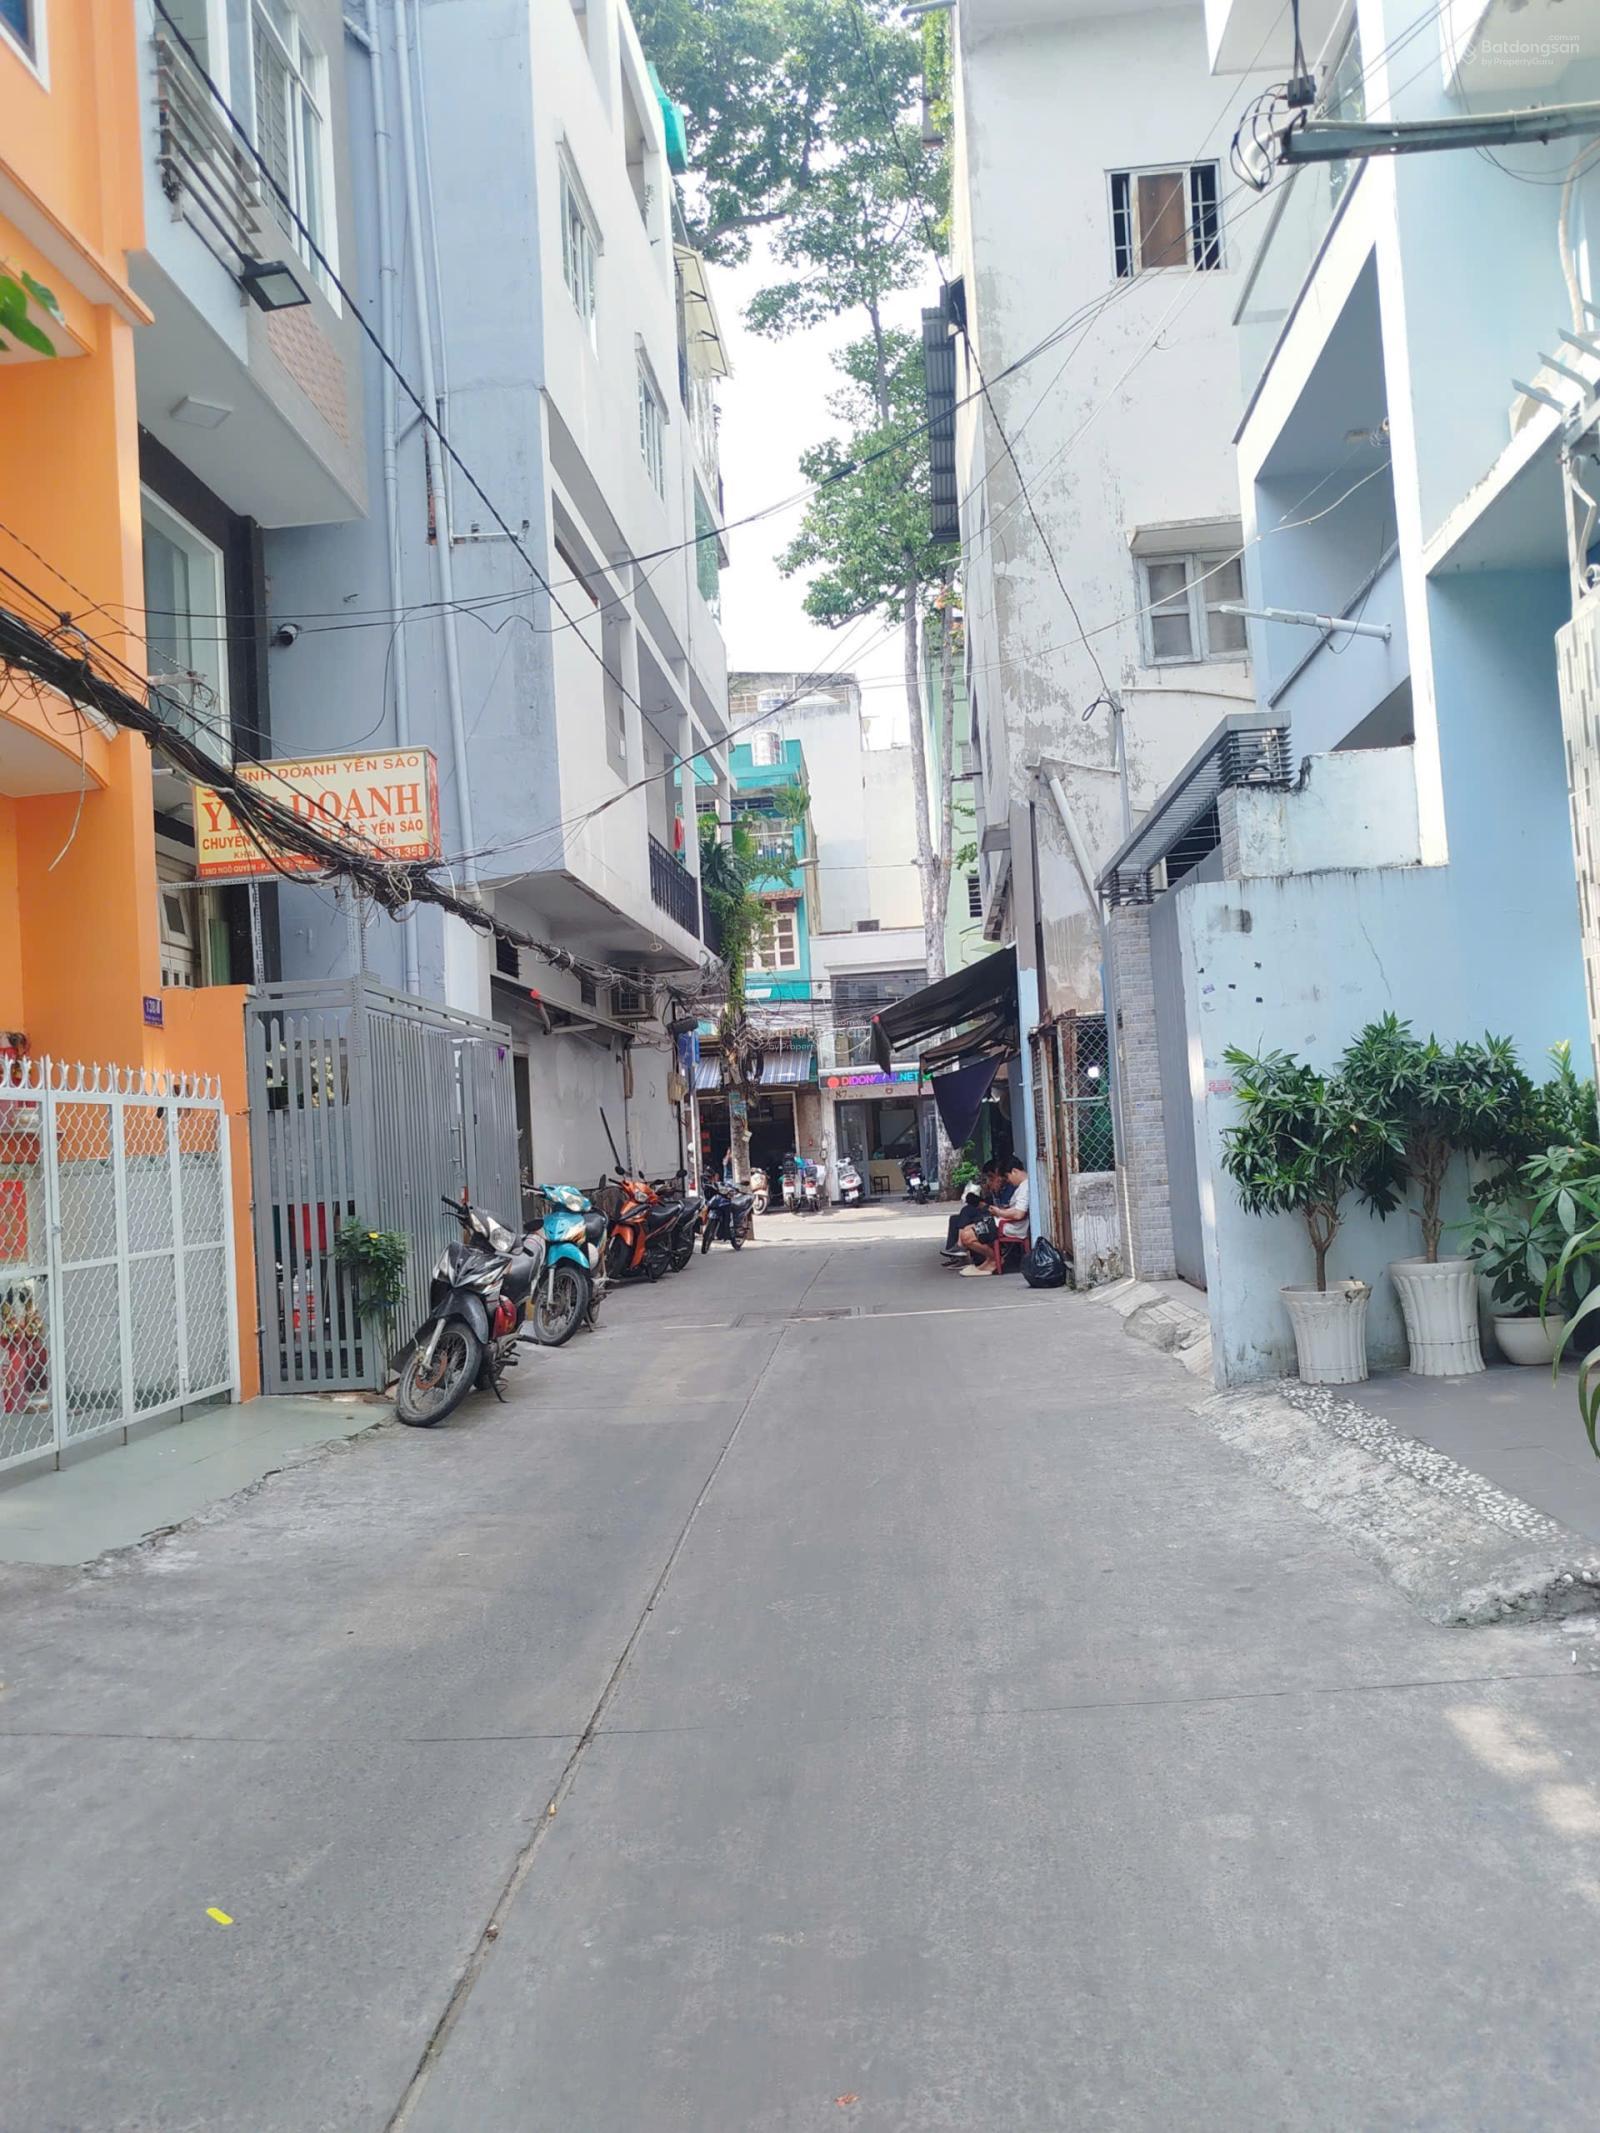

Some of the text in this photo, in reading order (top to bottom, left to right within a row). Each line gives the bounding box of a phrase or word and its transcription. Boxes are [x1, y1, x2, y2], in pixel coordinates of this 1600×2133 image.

[240, 769, 272, 783] INH
[278, 764, 337, 779] DOANH
[287, 783, 422, 825] DOANH
